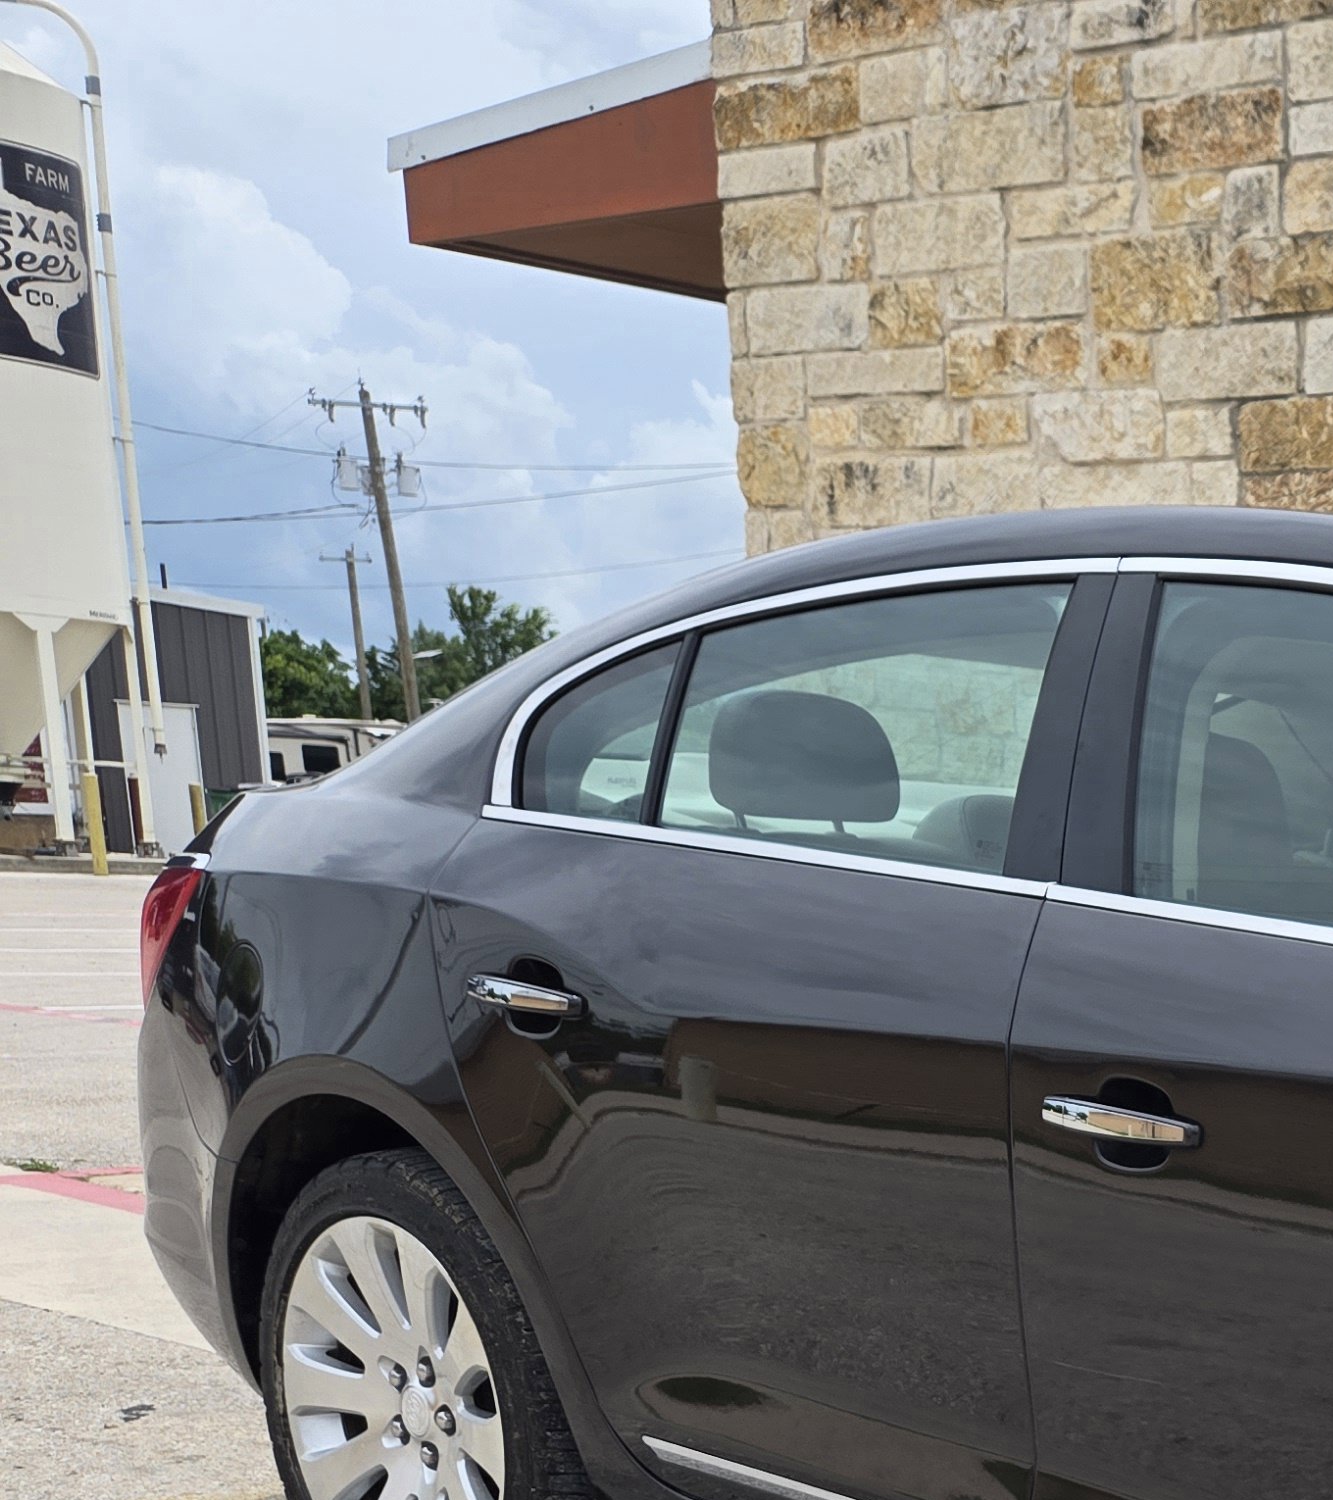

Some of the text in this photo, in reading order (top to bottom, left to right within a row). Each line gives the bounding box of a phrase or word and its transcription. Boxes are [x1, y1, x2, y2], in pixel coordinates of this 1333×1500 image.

[25, 163, 70, 193] FARM
[0, 236, 81, 283] Beer
[26, 288, 60, 309] CO.
